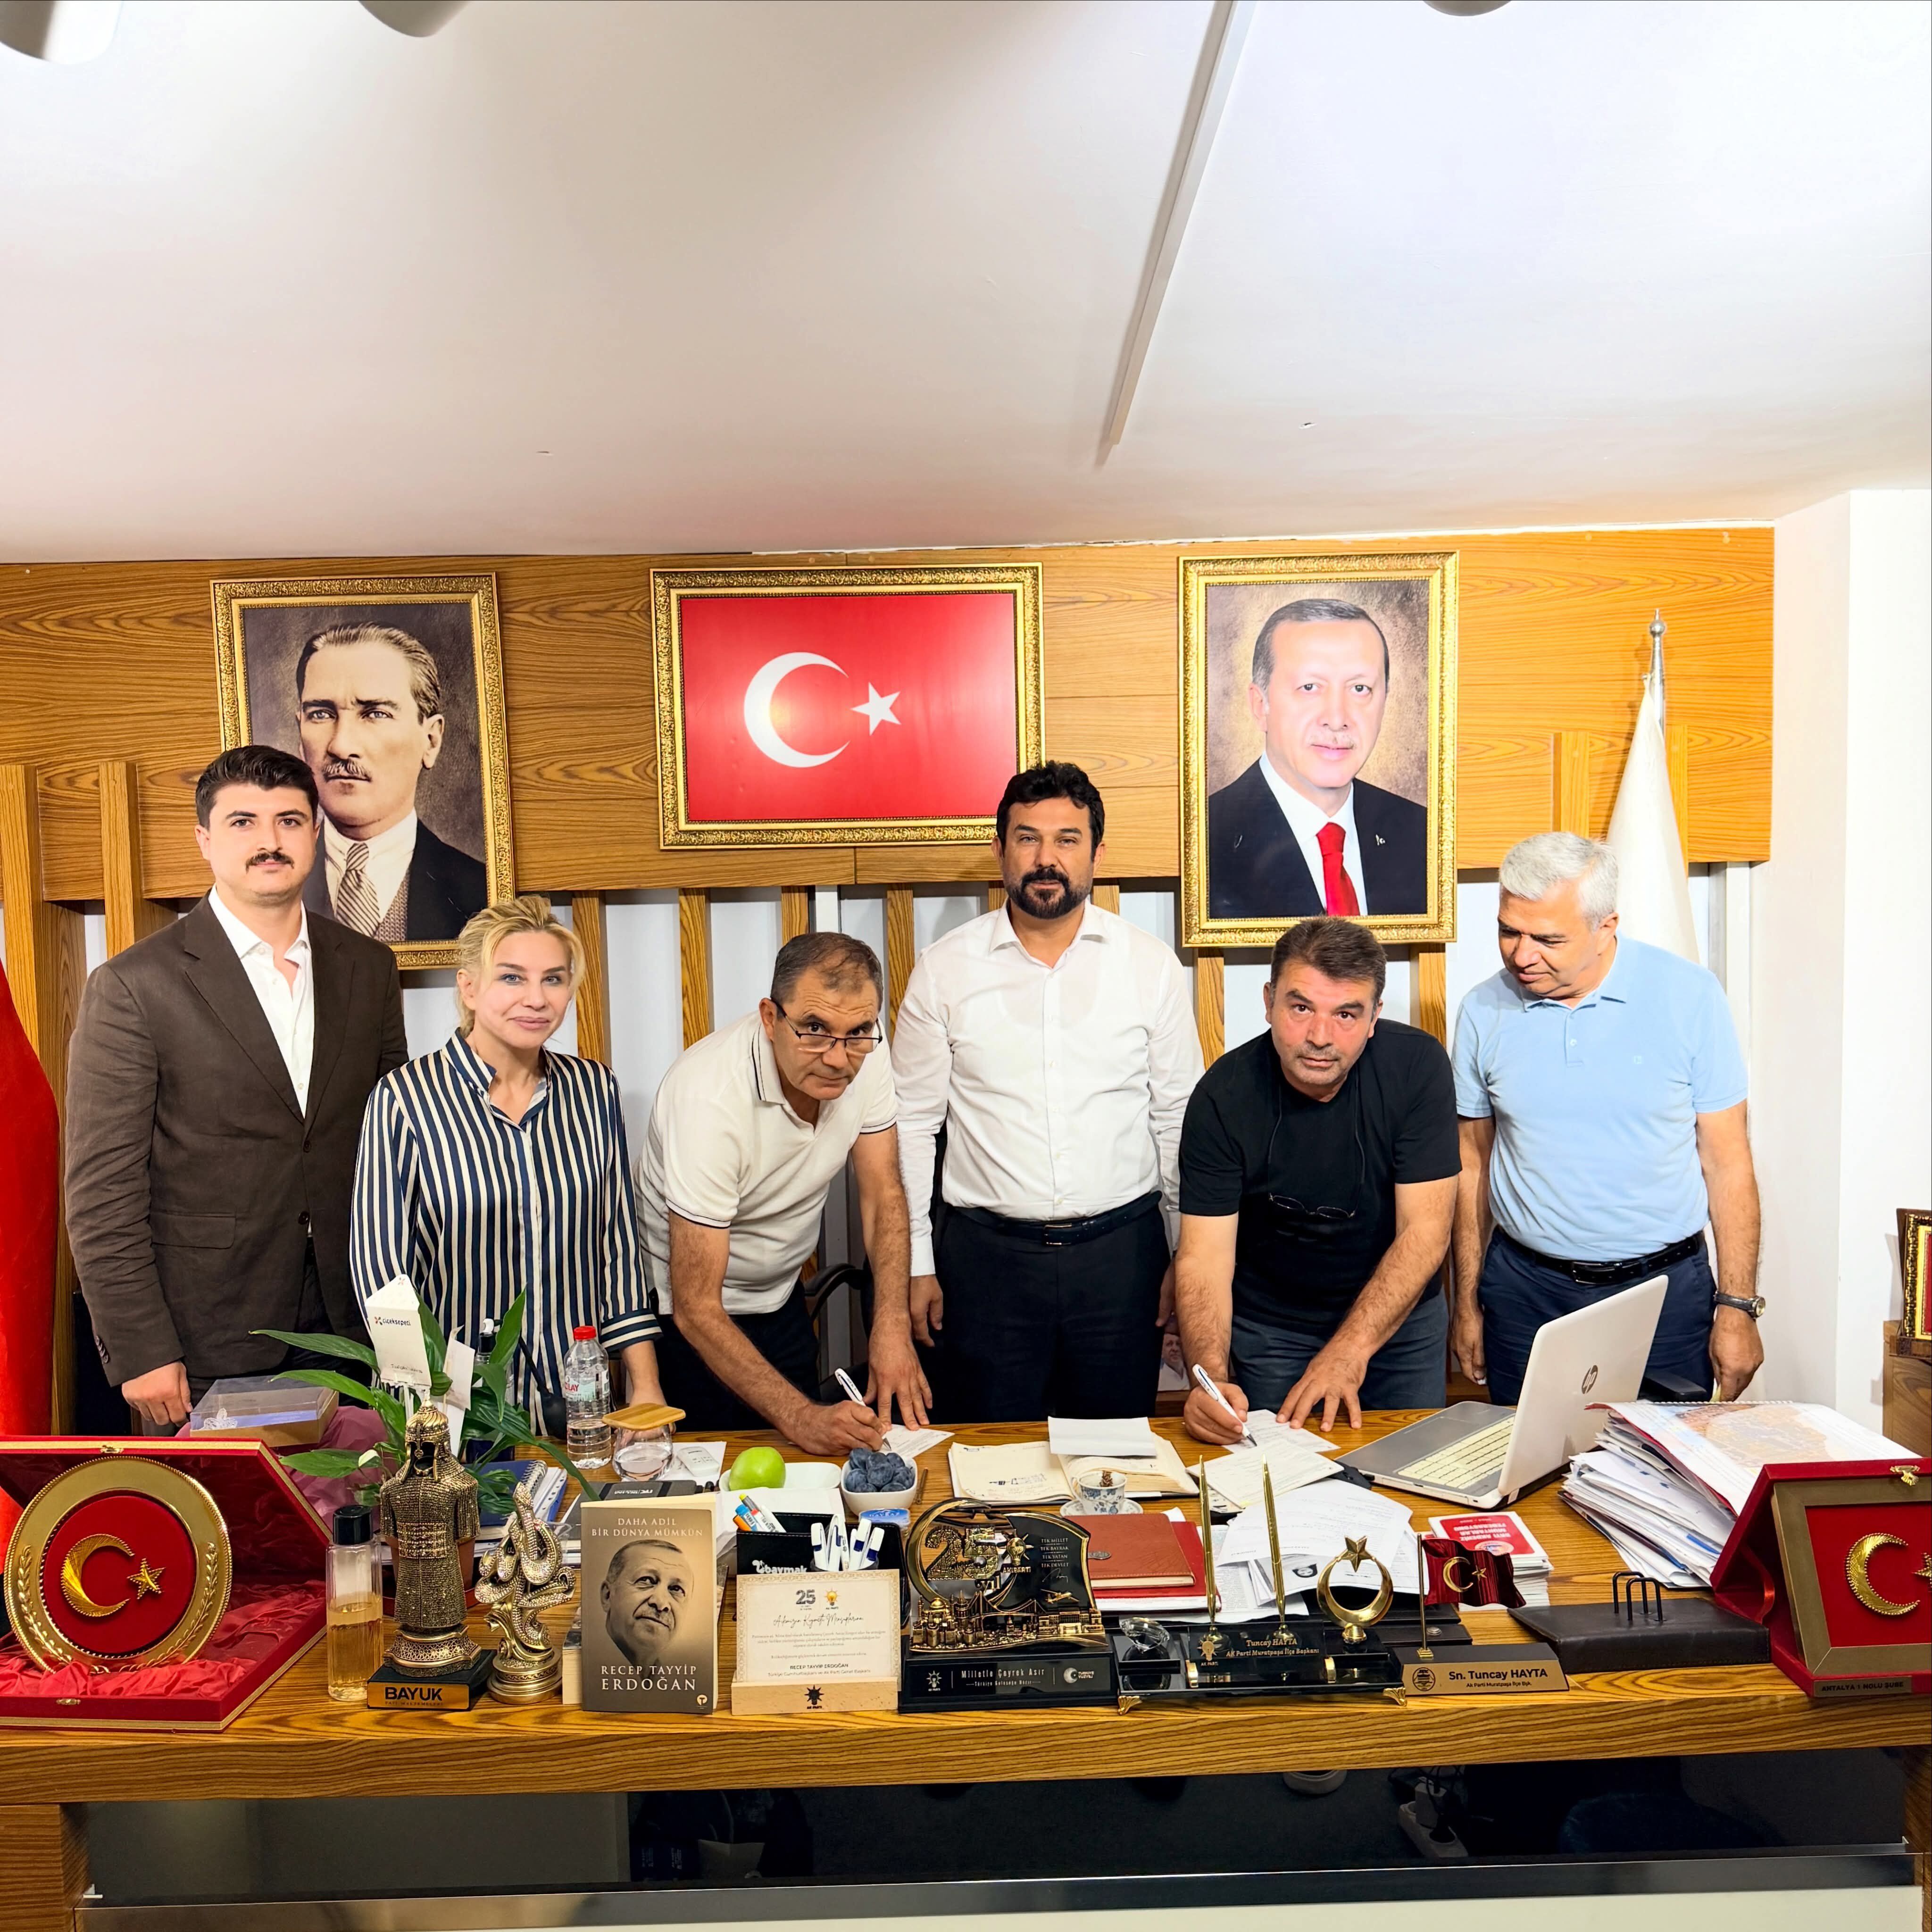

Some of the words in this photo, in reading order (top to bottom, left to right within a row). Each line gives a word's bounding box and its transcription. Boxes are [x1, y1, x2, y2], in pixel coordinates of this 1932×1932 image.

[651, 1516, 676, 1525] ADİL
[591, 1527, 609, 1536] BİR
[613, 1528, 650, 1536] DÜNYA
[654, 1528, 702, 1536] MÜMKÜN
[764, 1564, 808, 1574] baymak
[796, 1589, 816, 1605] 25
[1272, 1638, 1297, 1646] HAYTA
[601, 1666, 642, 1674] RECEP
[650, 1664, 696, 1674] TAYYİP
[961, 1669, 993, 1678] Milletle
[998, 1669, 1024, 1678] Çeyrek
[1029, 1668, 1045, 1676] Asır
[1449, 1671, 1466, 1680] Sn.
[1468, 1670, 1508, 1680] Tuncay
[1511, 1668, 1548, 1678] HAYTA
[602, 1676, 695, 1690] ERDOĞAN
[385, 1686, 442, 1701] BAYUK
